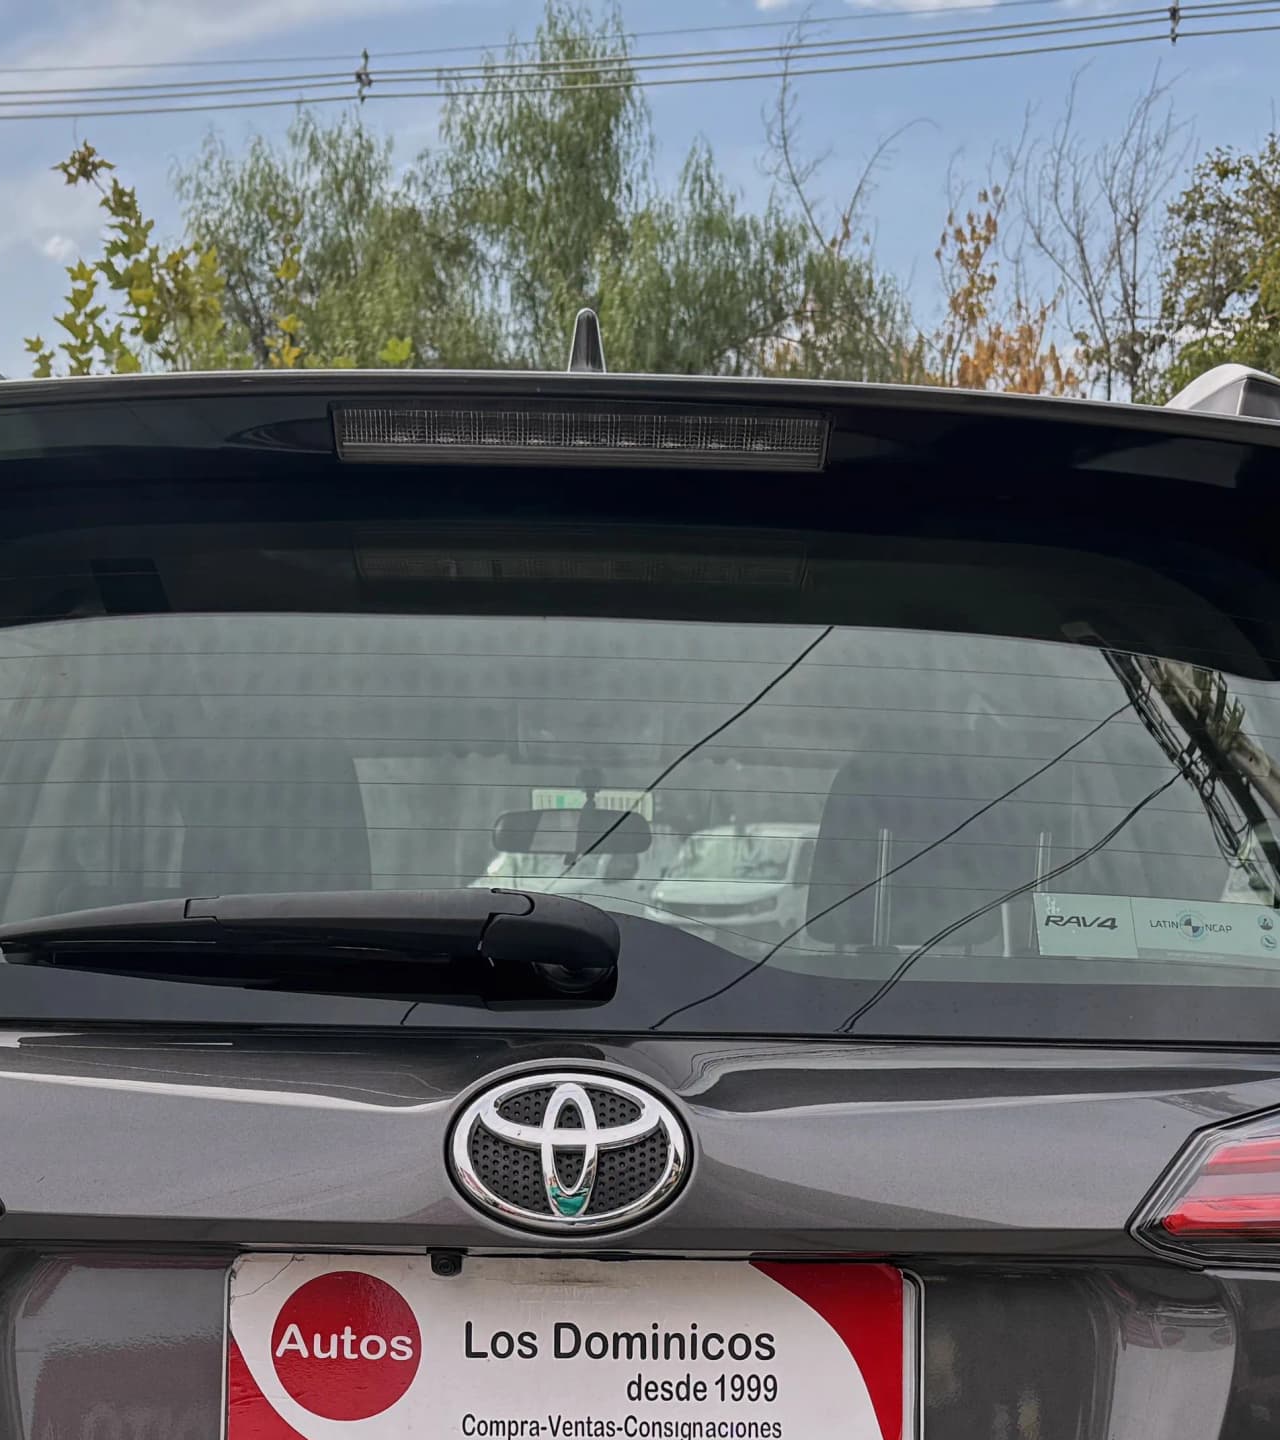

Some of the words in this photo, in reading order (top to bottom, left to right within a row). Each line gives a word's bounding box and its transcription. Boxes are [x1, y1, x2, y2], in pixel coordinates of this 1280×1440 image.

[1044, 914, 1119, 931] RAV4
[1149, 919, 1179, 929] LATIN
[1205, 923, 1233, 934] NCAP
[275, 1323, 414, 1361] Autos
[464, 1320, 538, 1360] Los
[553, 1321, 777, 1361] Dominicos
[626, 1373, 708, 1402] desde
[714, 1374, 778, 1402] 1999
